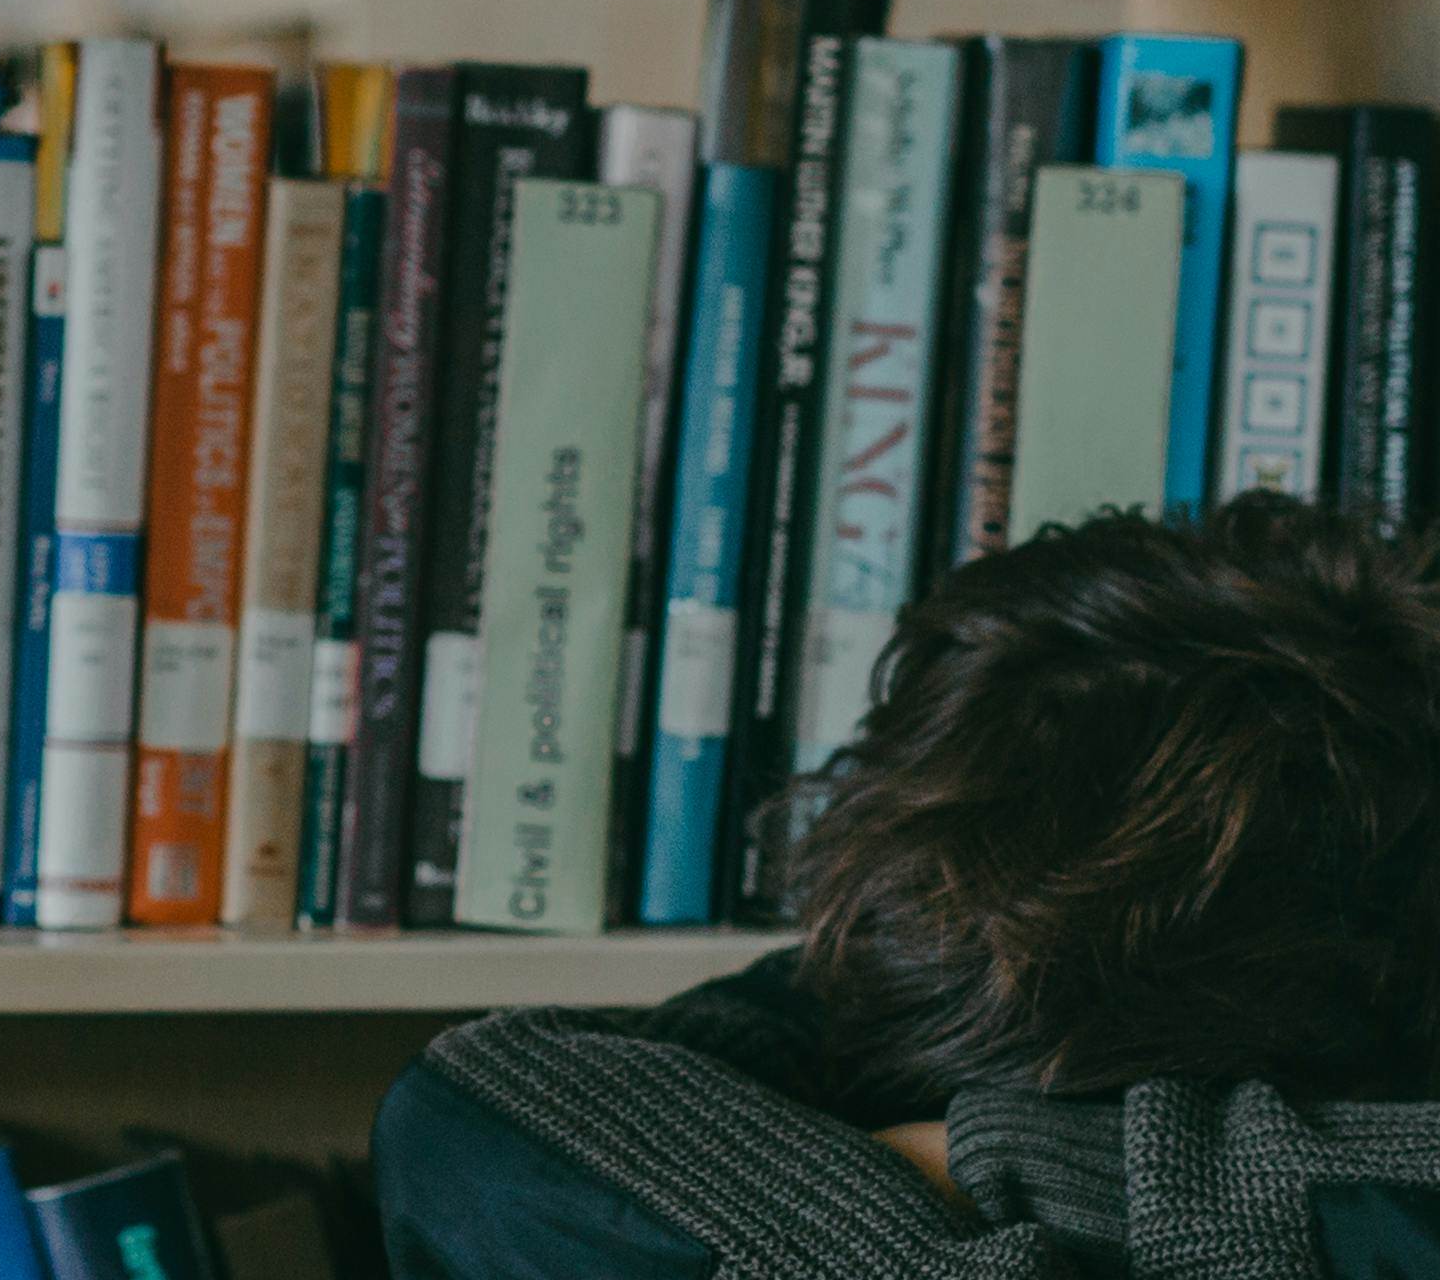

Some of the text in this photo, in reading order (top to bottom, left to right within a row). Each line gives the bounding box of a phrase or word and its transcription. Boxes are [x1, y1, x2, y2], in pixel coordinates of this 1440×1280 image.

[211, 94, 256, 246] WOMEN
[803, 36, 841, 156] MARTIN
[511, 446, 583, 922] Civil & political rights
